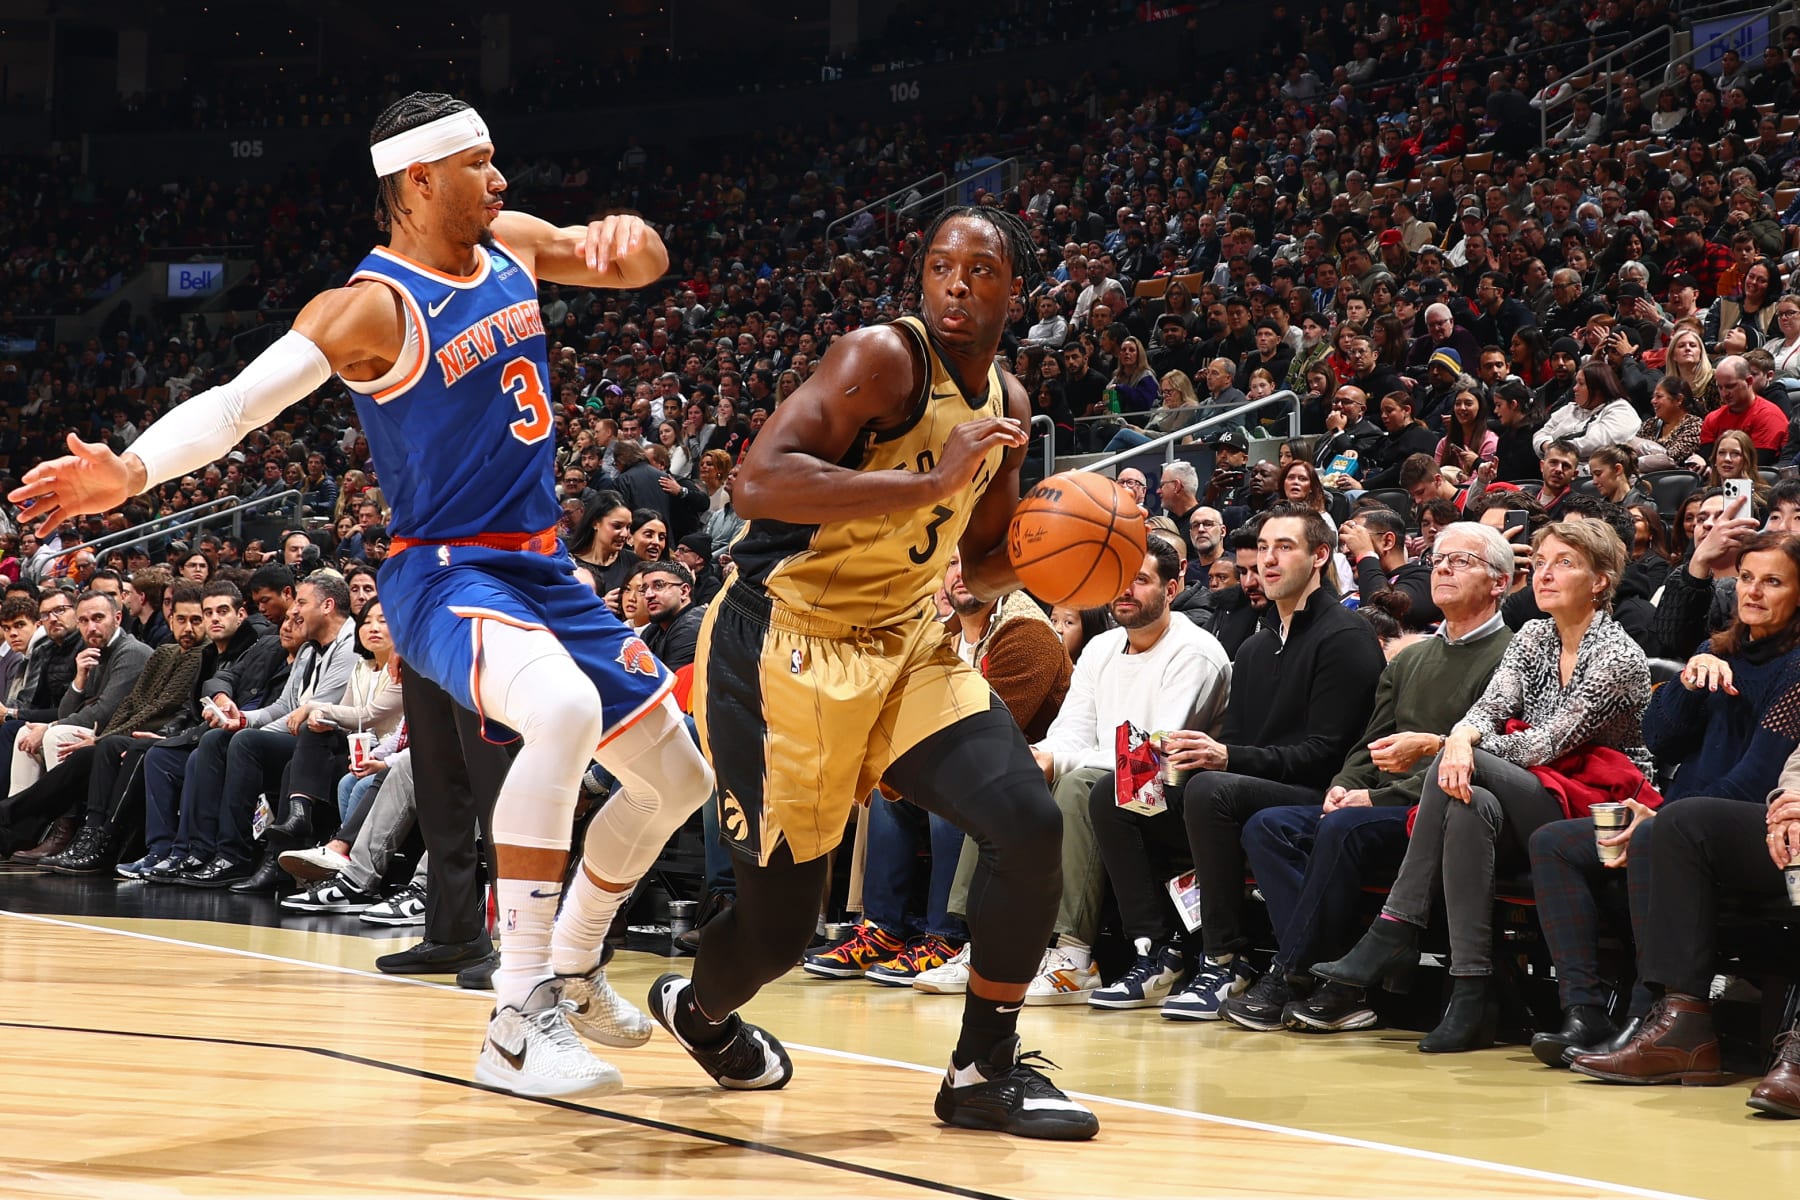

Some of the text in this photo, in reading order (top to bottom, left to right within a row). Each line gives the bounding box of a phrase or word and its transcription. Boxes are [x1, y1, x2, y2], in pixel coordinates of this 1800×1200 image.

[1710, 27, 1752, 62] Bll
[890, 81, 919, 102] 106
[230, 140, 263, 157] 105
[180, 270, 211, 289] Bell
[434, 320, 498, 388] NEW
[501, 356, 554, 446] 3
[908, 504, 955, 564] 3
